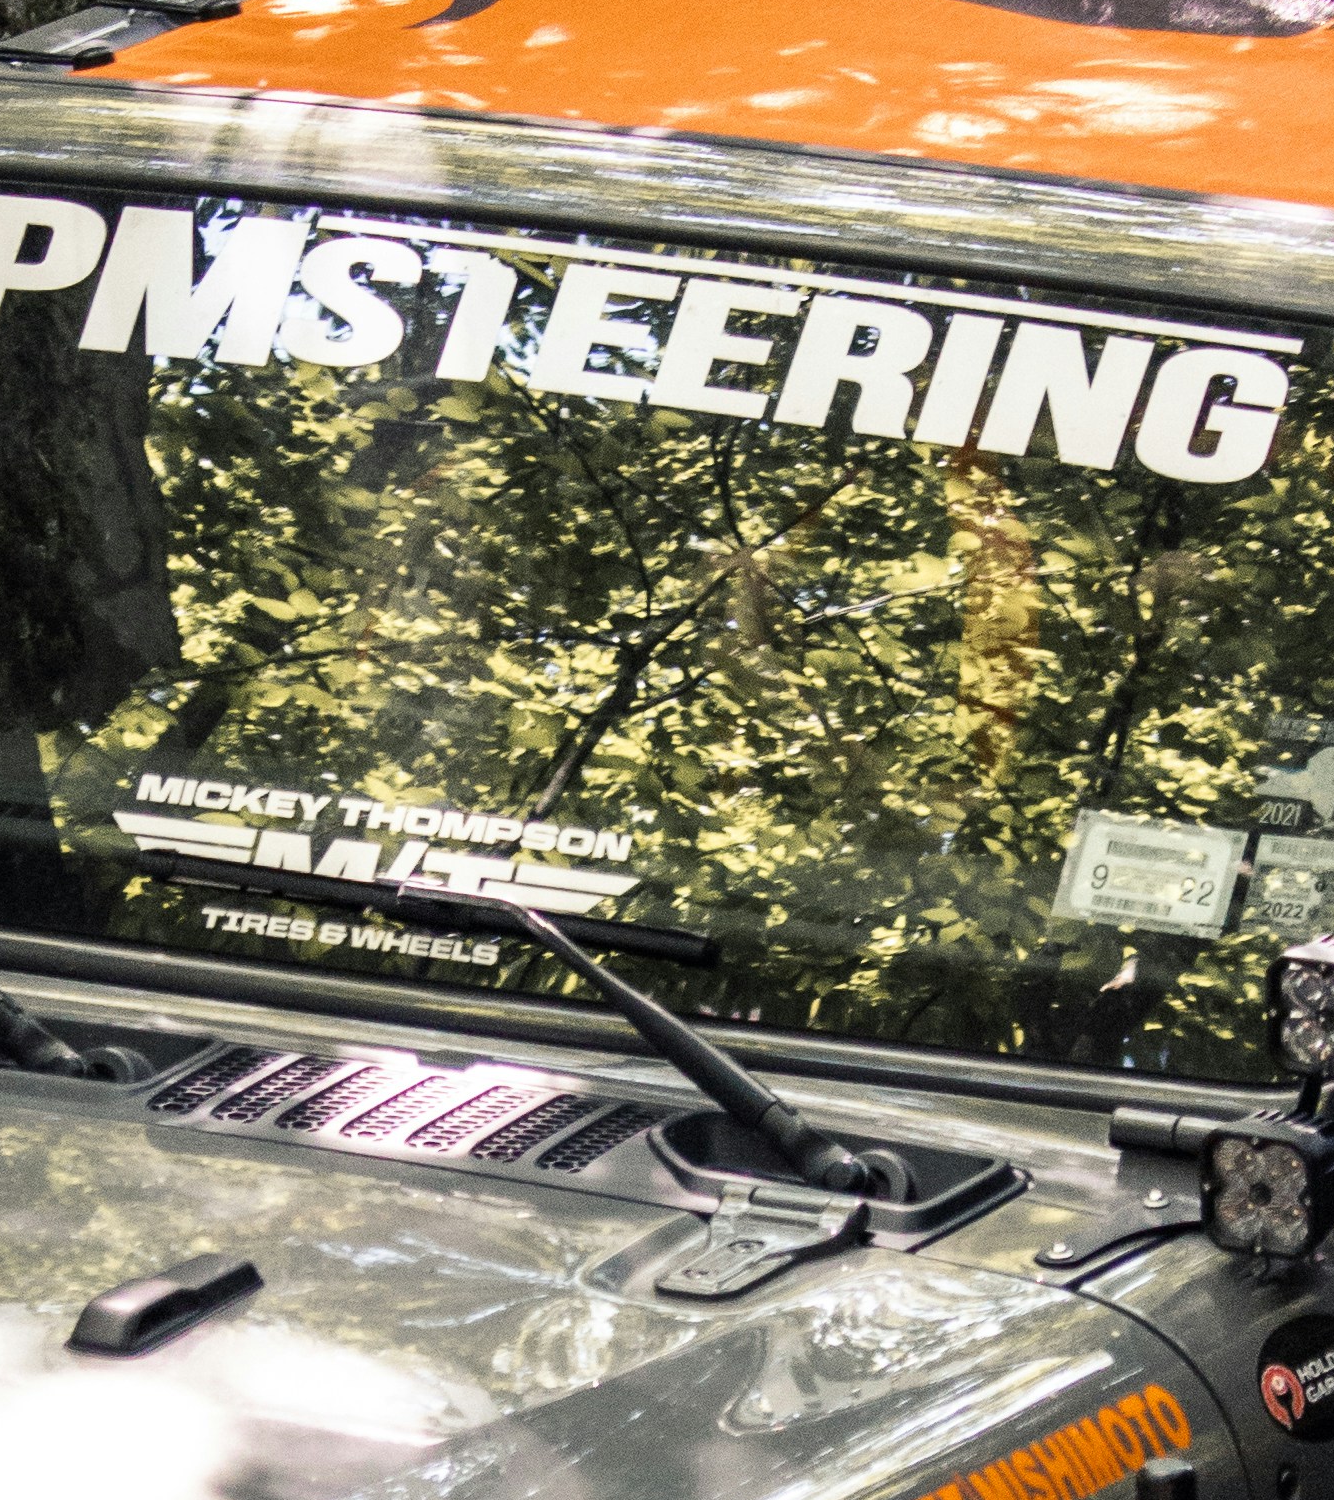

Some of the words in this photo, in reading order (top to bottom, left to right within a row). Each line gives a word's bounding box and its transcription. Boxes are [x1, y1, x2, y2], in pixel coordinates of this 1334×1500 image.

[135, 773, 332, 821] MICKEY
[338, 798, 633, 861] THOMPSON
[1259, 801, 1302, 826] 2021
[1090, 863, 1109, 890] 9
[1179, 876, 1216, 907] 22
[201, 907, 315, 943] TIRES
[318, 922, 347, 945] &
[350, 928, 500, 967] WHEELS
